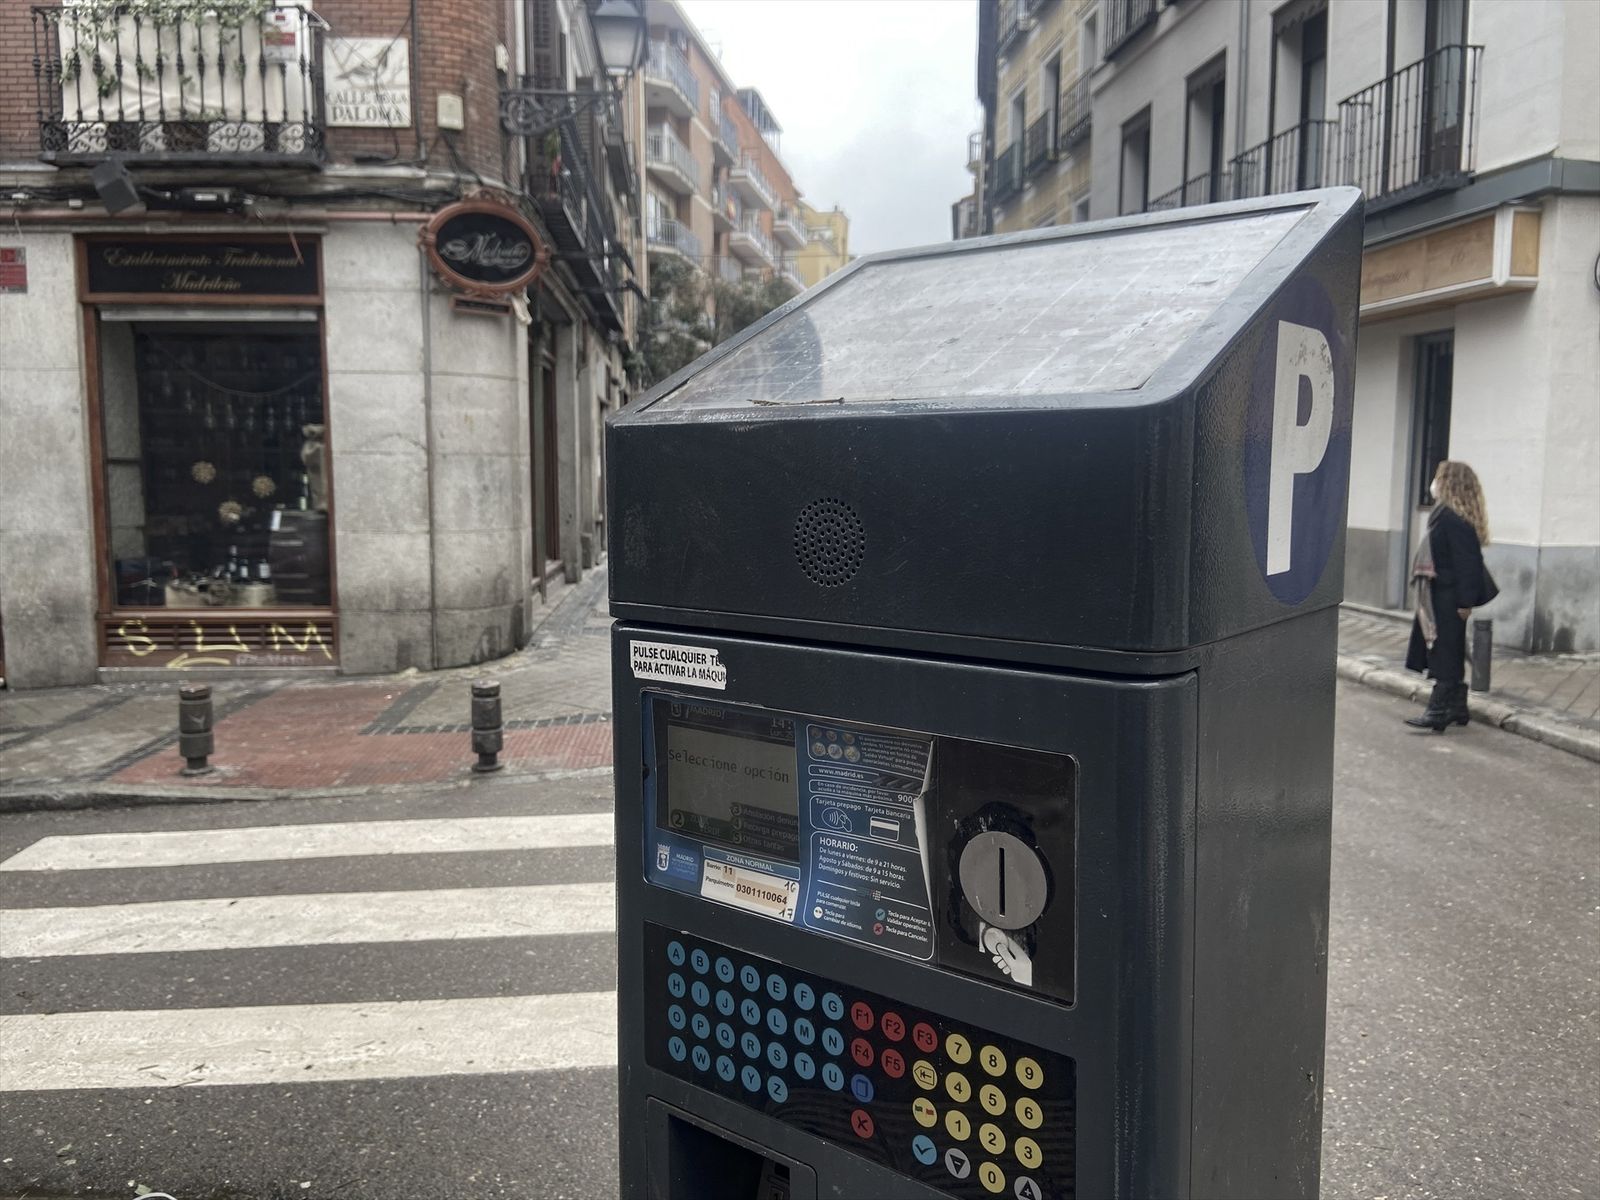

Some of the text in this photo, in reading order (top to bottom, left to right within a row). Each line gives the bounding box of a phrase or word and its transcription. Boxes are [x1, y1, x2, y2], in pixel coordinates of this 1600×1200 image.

[1266, 320, 1334, 576] P
[633, 645, 721, 667] PULSE CUALQUIER TE
[633, 660, 653, 673] PARA
[654, 663, 686, 677] ACTIVAR
[687, 666, 698, 679] LA
[668, 749, 789, 784] Seleccione opción
[818, 768, 864, 779] www.madrid.es
[815, 798, 862, 811] Tarjeta prepago
[897, 794, 913, 804] 900
[864, 805, 911, 820] Tarjeta bancaria
[819, 837, 859, 852] HORARIO:
[726, 854, 774, 872] ZONA NORMAL
[819, 855, 837, 865] Agosto
[882, 869, 889, 877] 15
[827, 848, 841, 857] lunes
[866, 857, 874, 865] de
[723, 865, 733, 875] 11
[818, 863, 844, 875] Domingos
[870, 875, 879, 883] Sin
[736, 883, 788, 905] 0301110064
[888, 910, 899, 918] Tecla
[910, 916, 927, 926] Aceptar
[885, 925, 897, 934] Tecla
[672, 948, 1034, 1080] A B C D E F G F1 F2 F3 7 8 9
[673, 979, 680, 991] H
[722, 998, 728, 1009] J
[746, 1006, 755, 1018] K
[773, 1016, 780, 1028] L
[800, 1025, 809, 1039] M
[829, 1034, 837, 1048] N
[855, 1044, 870, 1060] F4
[885, 1055, 900, 1071] F5
[953, 1081, 963, 1095] 4
[988, 1093, 997, 1107] 5
[1025, 1106, 1034, 1120] 6
[673, 1011, 1033, 1160] O P Q R S T U 1 2 3
[673, 1042, 996, 1184] V W X Y Z 0
